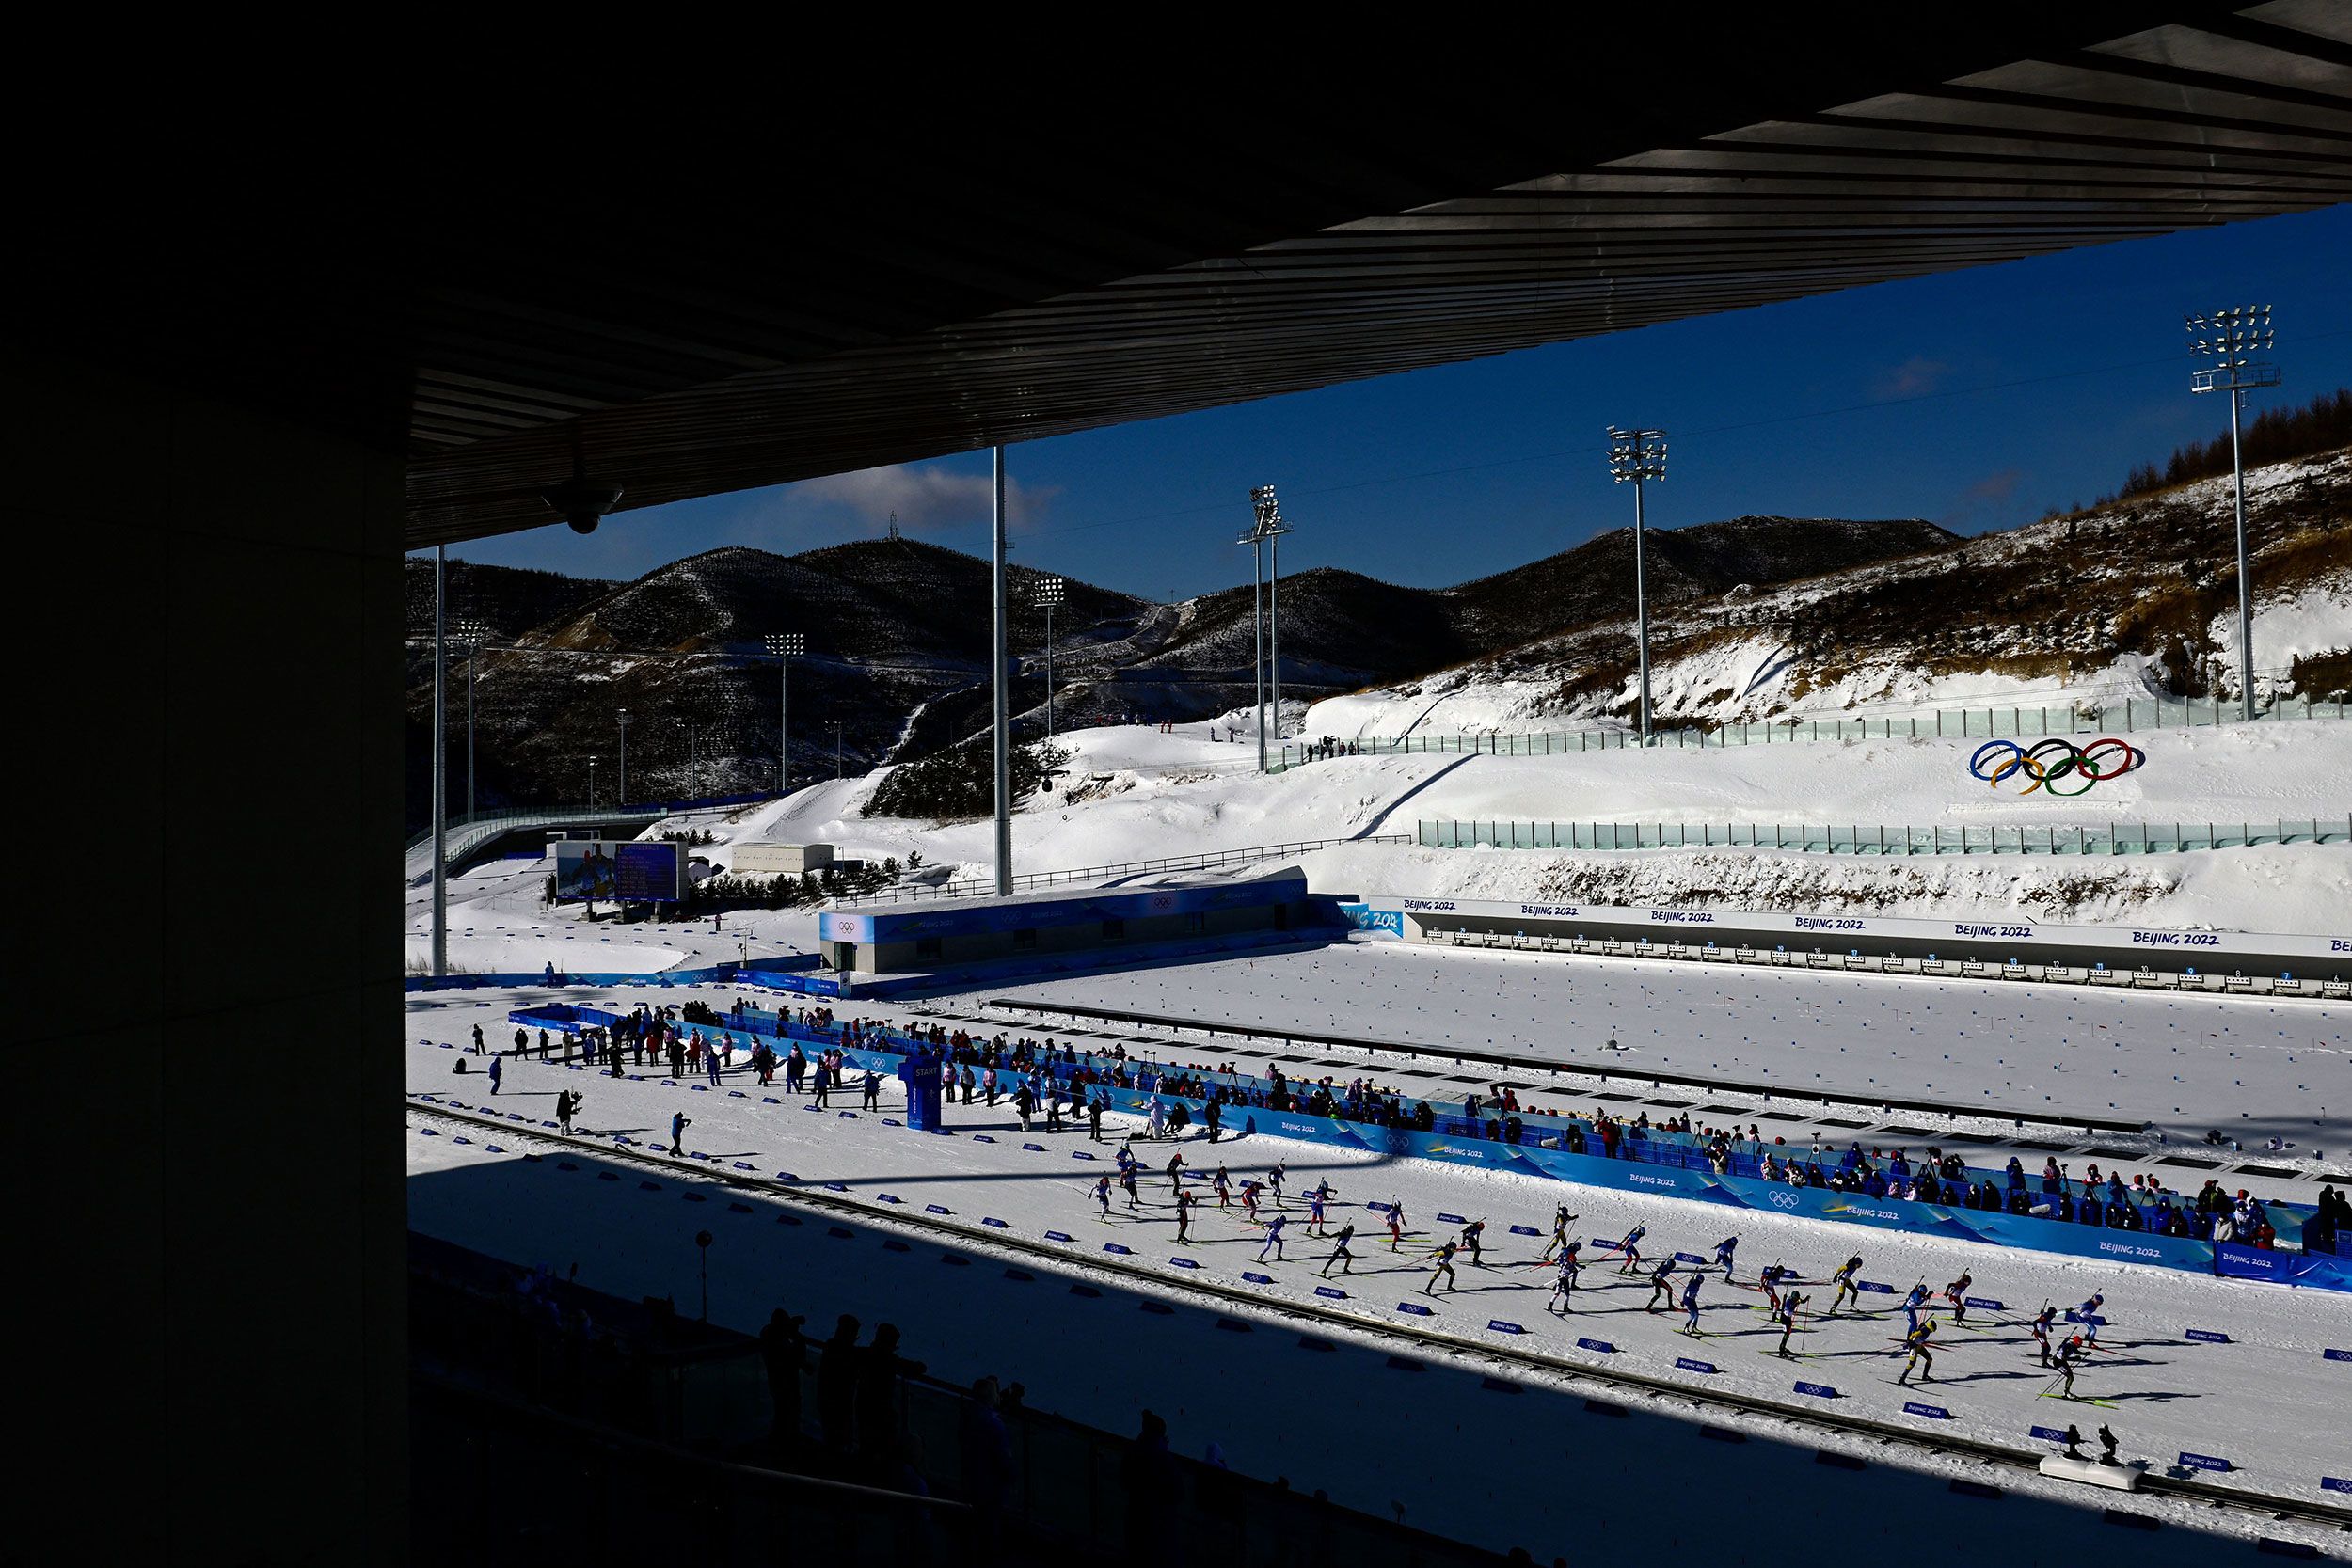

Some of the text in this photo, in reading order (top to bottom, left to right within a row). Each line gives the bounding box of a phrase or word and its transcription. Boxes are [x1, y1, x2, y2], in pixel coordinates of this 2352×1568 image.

[1405, 899, 1456, 911] BEIJING 2022
[1521, 905, 1579, 916] BEIJING 2022
[1651, 911, 1714, 923] BEIJING 2022
[1795, 917, 1866, 929] BEIJING 2022
[1955, 925, 2033, 938] BEIJING 2022
[2132, 931, 2220, 946] BEIJING 2022
[915, 1067, 937, 1076] START
[1444, 1147, 1465, 1156] BEIJING
[1630, 1174, 1676, 1186] BEIJING 2022
[1847, 1206, 1899, 1220] BEIJING 2022
[2100, 1242, 2162, 1258] BEIJING 2022
[2223, 1253, 2273, 1268] BEIJING 2022
[2184, 1456, 2204, 1465] BEIJING
